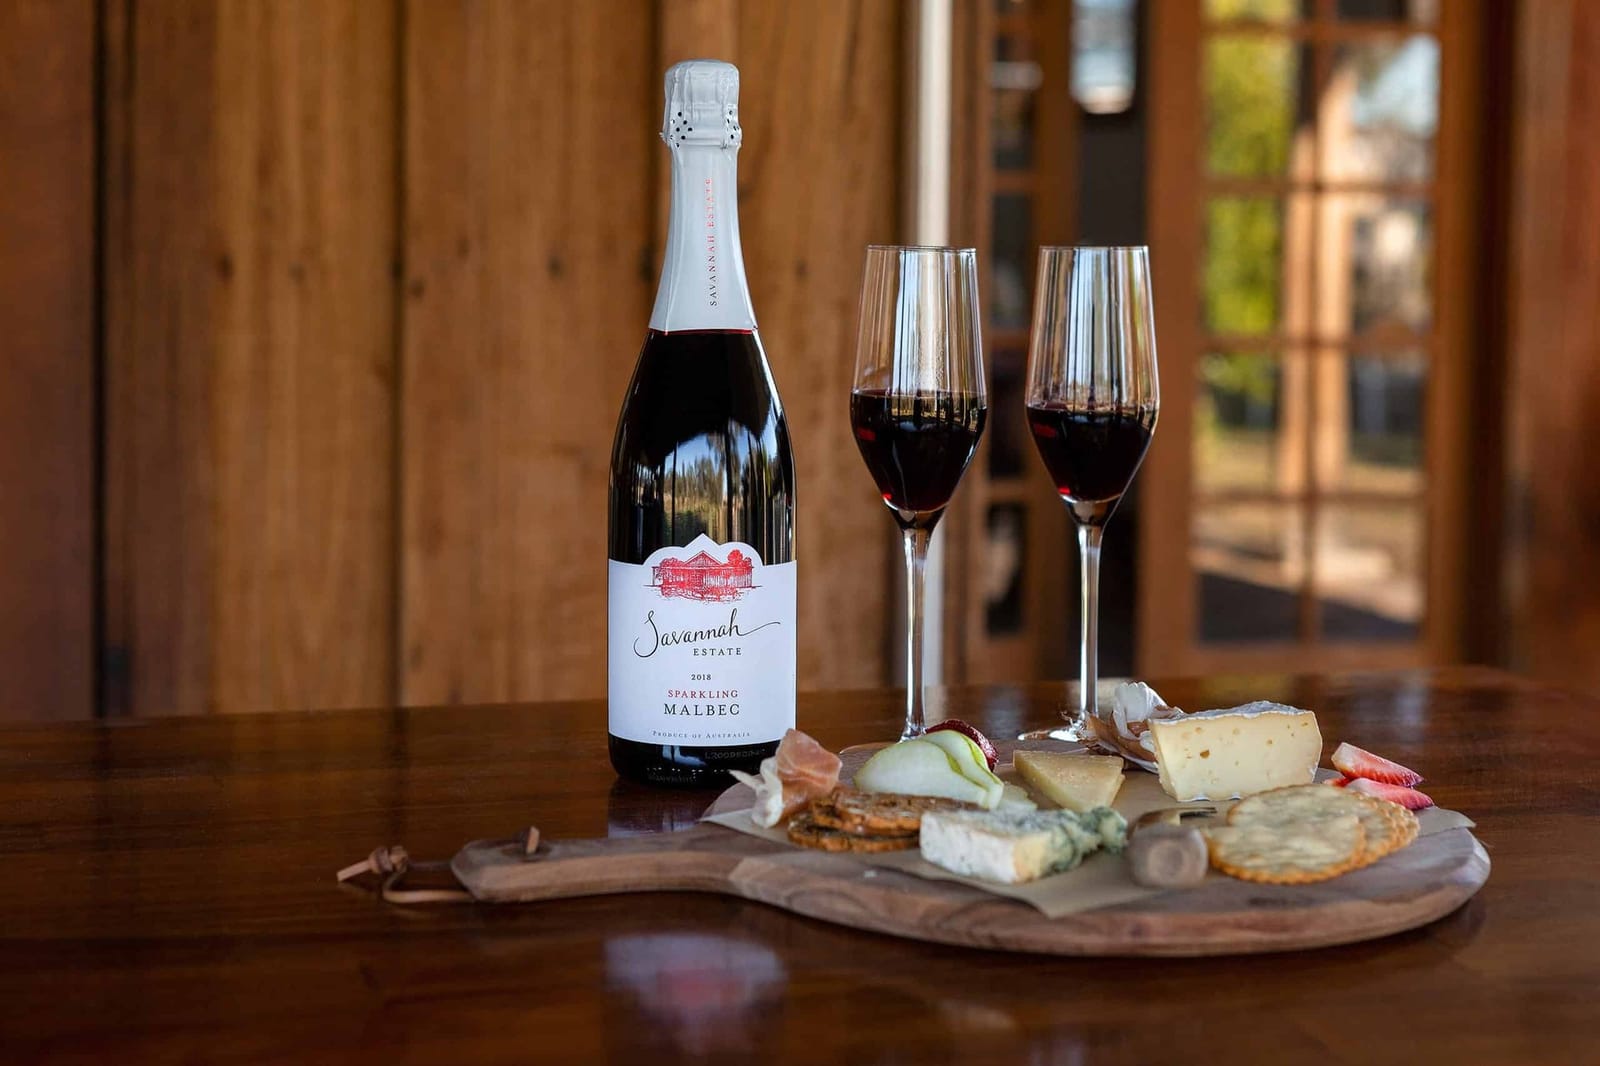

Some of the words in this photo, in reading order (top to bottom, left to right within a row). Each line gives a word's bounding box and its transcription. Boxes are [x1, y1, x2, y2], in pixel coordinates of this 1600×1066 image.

[705, 178, 714, 227] ESTATE
[707, 235, 717, 306] SAVANNAH
[633, 608, 780, 658] Savannah
[693, 647, 741, 657] ESTATE
[690, 673, 712, 681] 2018
[667, 689, 739, 699] SPARKLING
[663, 703, 740, 716] MALBEC
